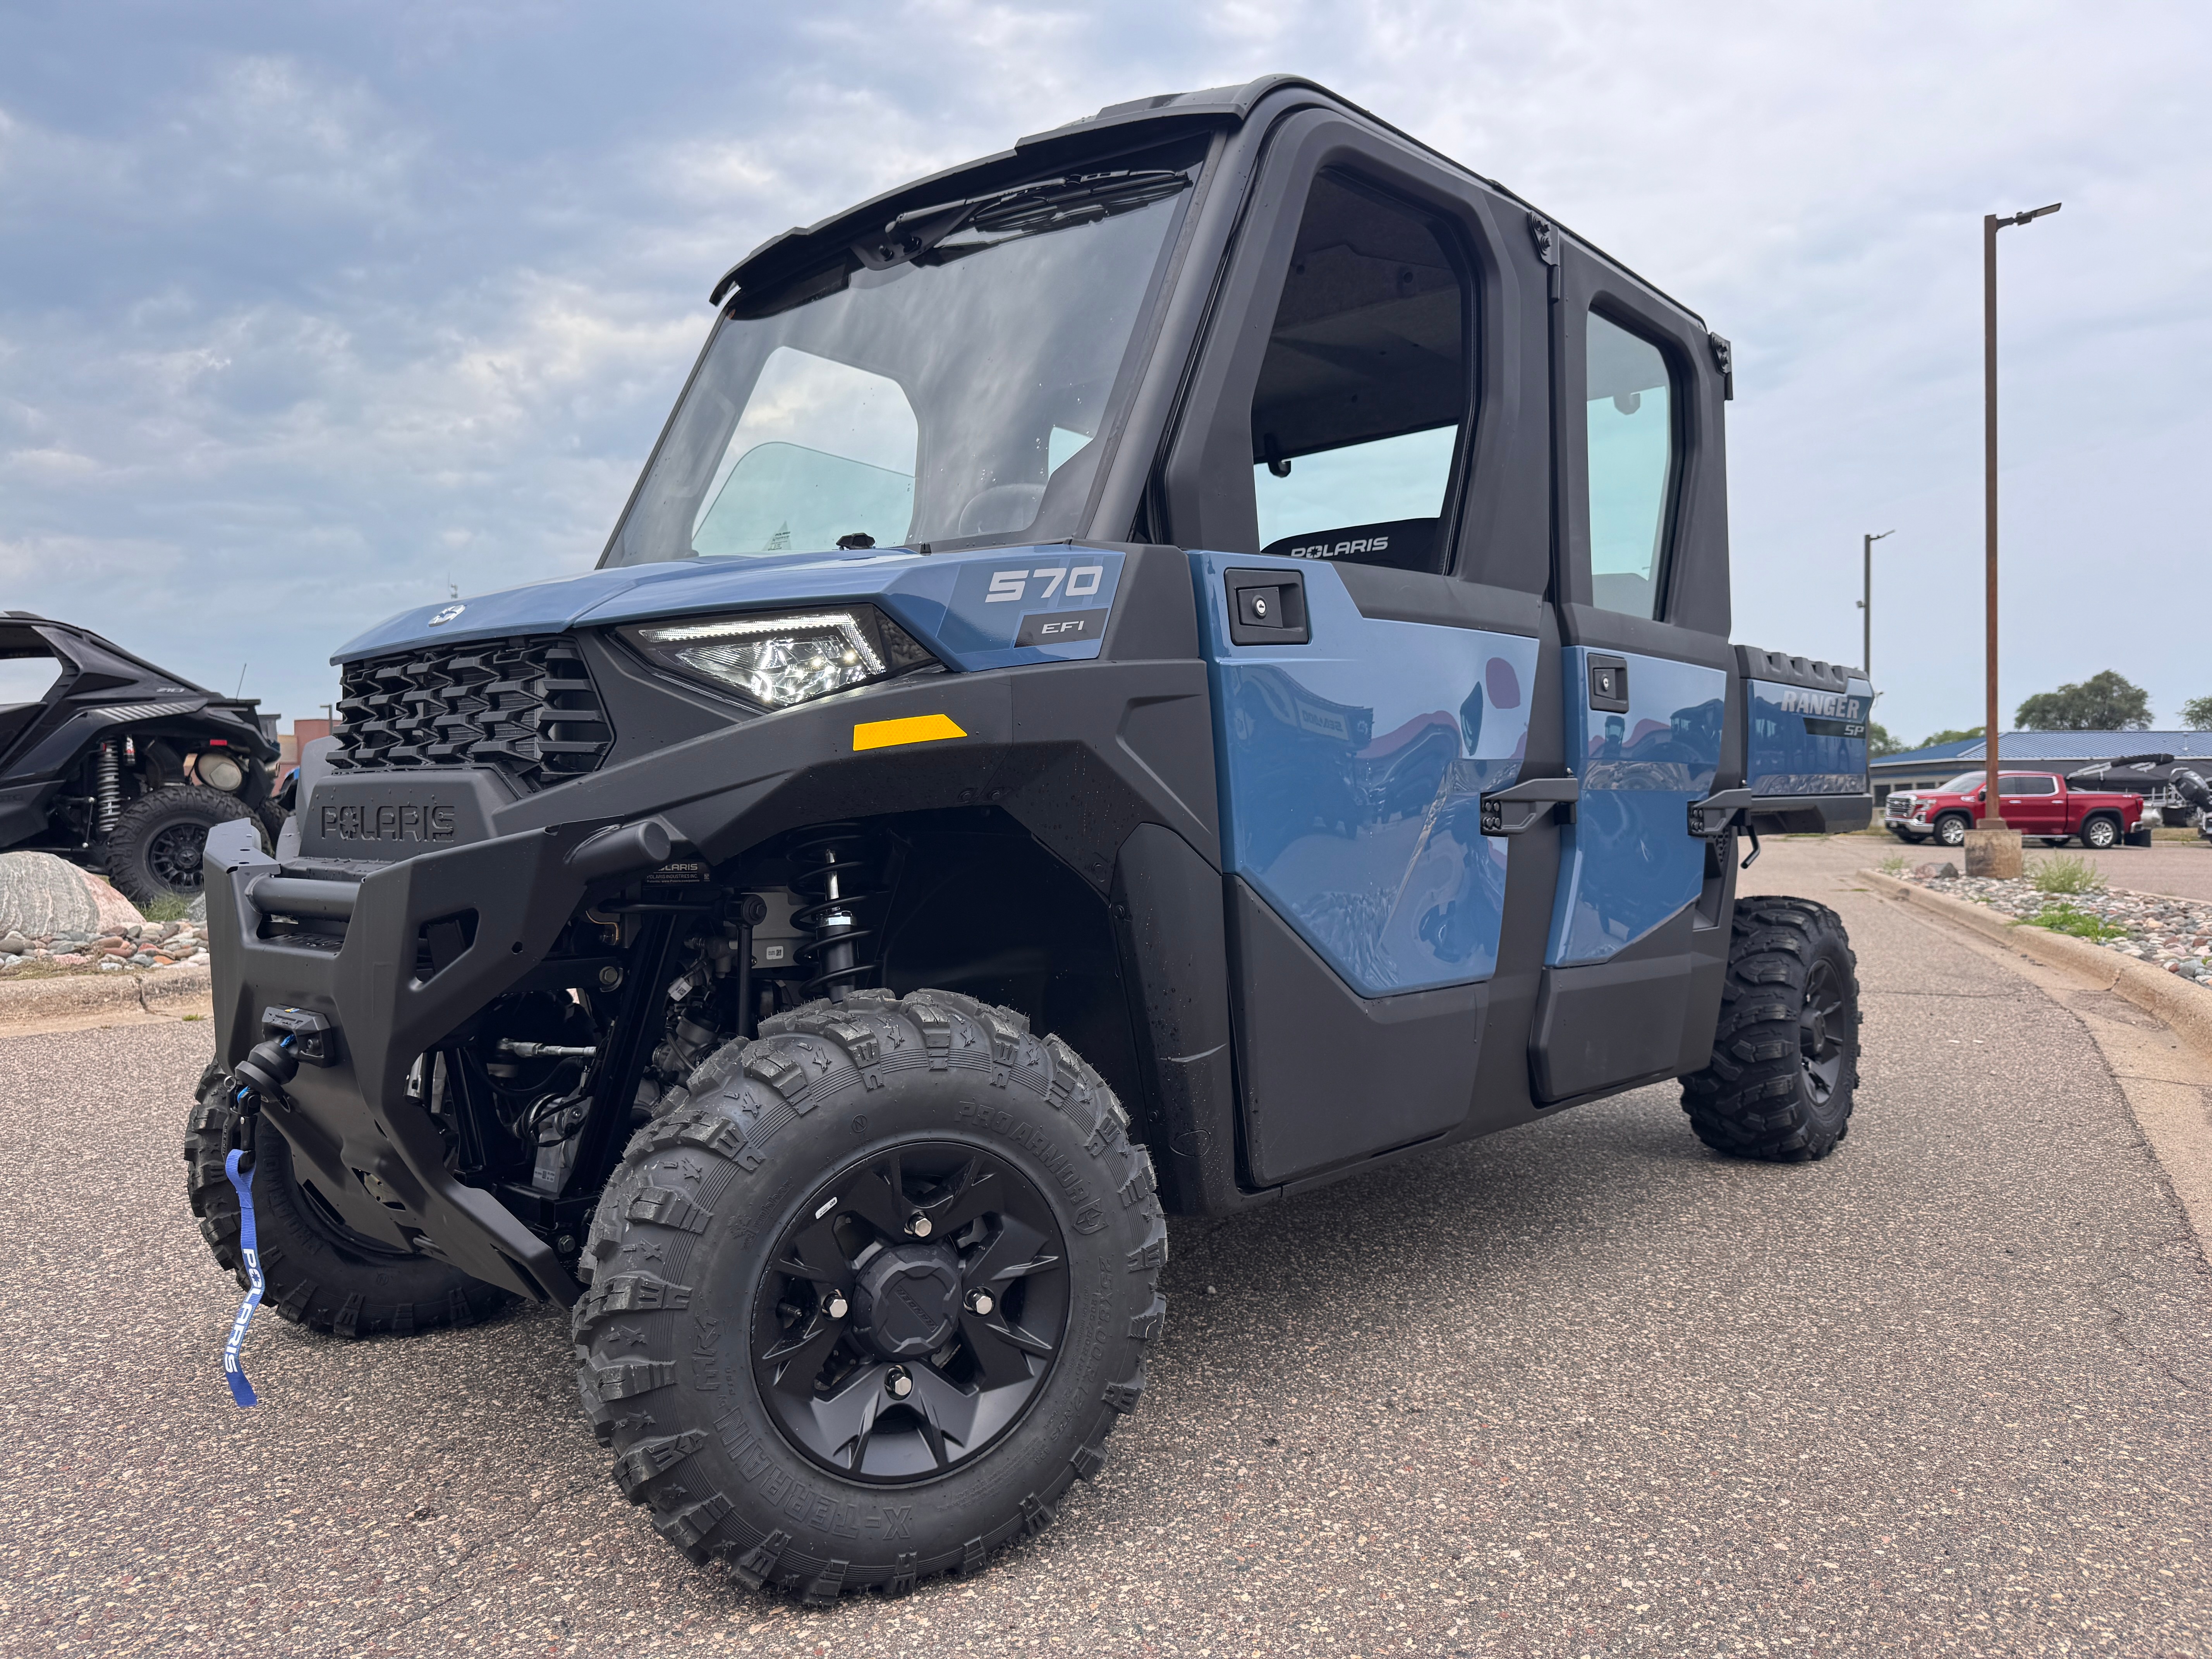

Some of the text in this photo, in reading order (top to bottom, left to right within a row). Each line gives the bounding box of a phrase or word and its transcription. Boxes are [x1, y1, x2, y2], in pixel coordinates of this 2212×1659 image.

[1291, 536, 1389, 558] POLARIS
[985, 566, 1103, 603] 570
[1041, 620, 1084, 634] EFI
[1781, 690, 1859, 719] RANGER
[1844, 725, 1864, 736] SP
[322, 806, 455, 842] POLARIS
[954, 1101, 1090, 1206] PRO ARMOR
[225, 1249, 262, 1373] POLARIS
[713, 1407, 912, 1540] X-TERRAIN
